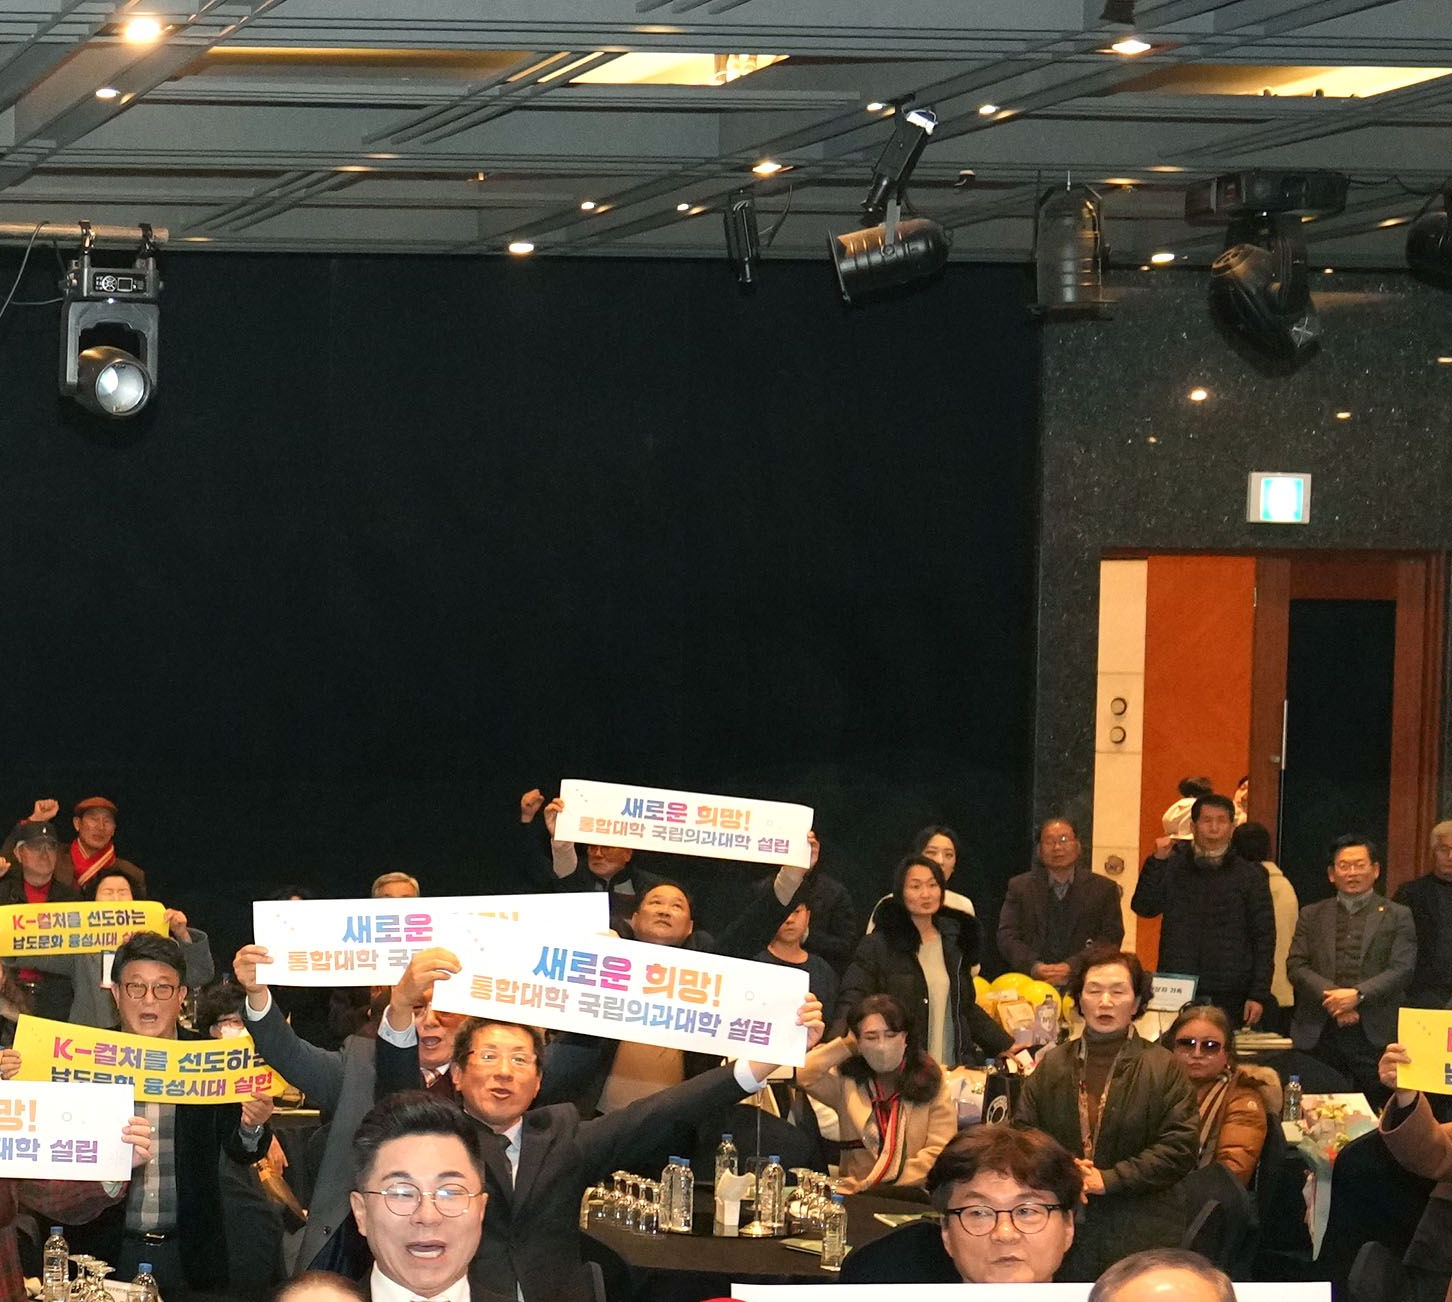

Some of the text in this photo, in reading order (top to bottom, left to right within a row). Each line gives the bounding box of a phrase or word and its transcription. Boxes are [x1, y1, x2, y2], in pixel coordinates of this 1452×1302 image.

[621, 797, 751, 831] 새로운 희망!
[578, 817, 790, 855] 통합대학 국립의과대학 설립
[13, 908, 146, 931] K-컬처를 선도하는
[342, 913, 433, 943] 새로운
[12, 933, 64, 951] 남도문화
[68, 931, 118, 949] 융성시대
[287, 949, 379, 972] 통합대학
[533, 946, 723, 1008] 새로운 희망!
[470, 973, 773, 1046] 통합대학 국립의과대학 설립
[53, 1036, 168, 1072] K-컬처를
[142, 1076, 227, 1098] 융성시대
[233, 1071, 273, 1093] 실현
[49, 1138, 99, 1164] 설립
